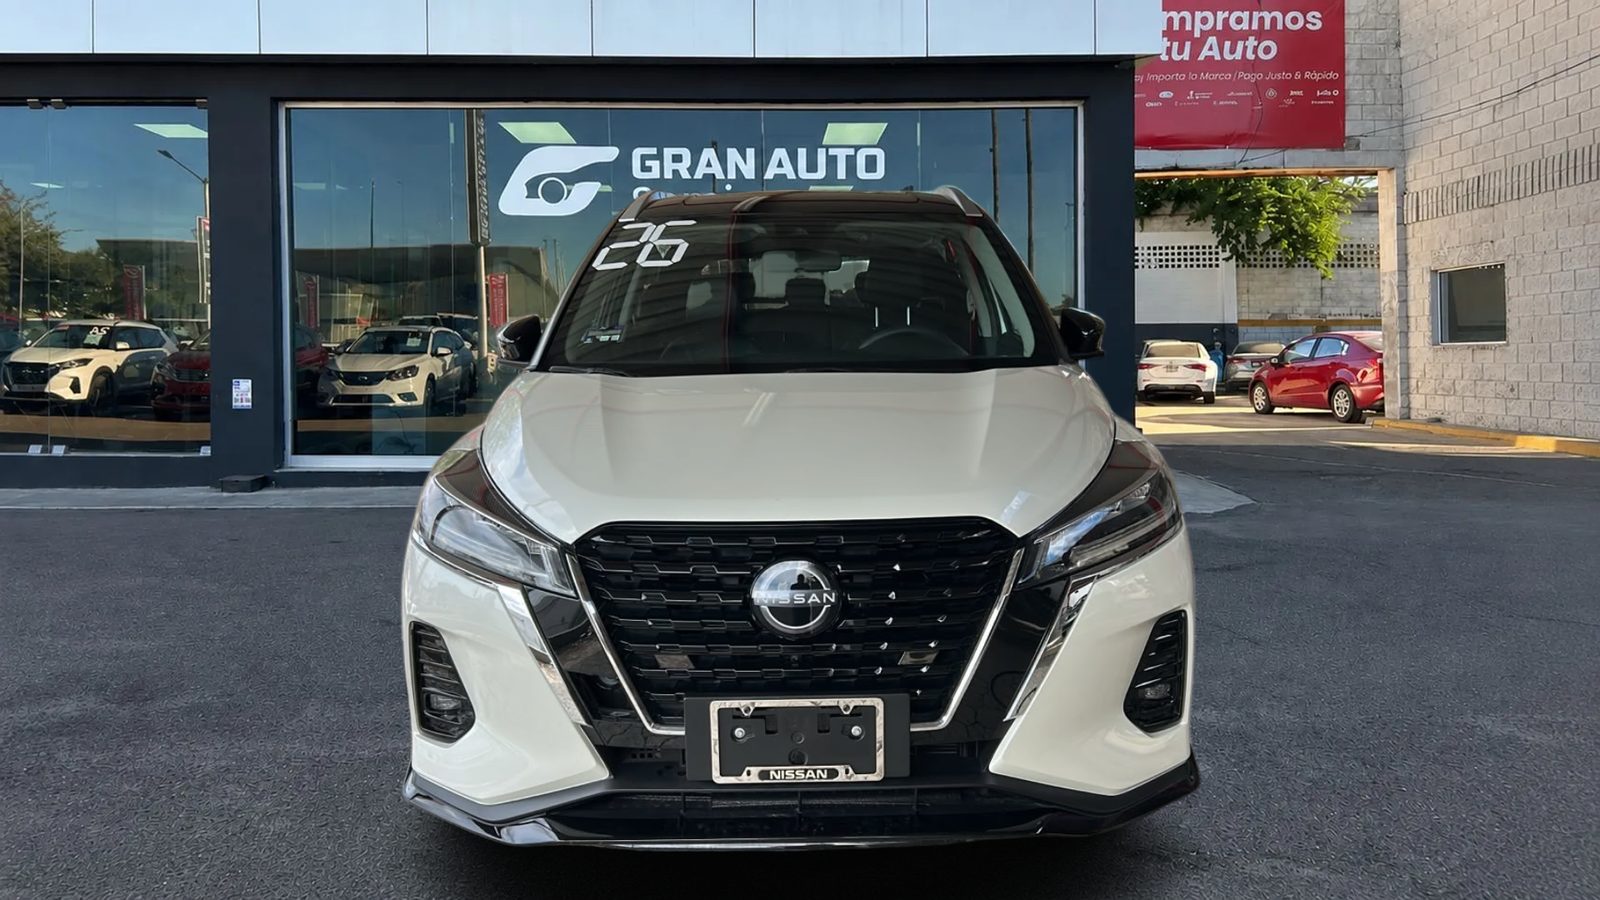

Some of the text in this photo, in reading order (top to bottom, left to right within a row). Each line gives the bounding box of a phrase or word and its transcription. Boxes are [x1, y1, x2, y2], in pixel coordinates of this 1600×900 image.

[1160, 36, 1278, 61] tu Auto
[1146, 73, 1186, 83] Importa
[1188, 72, 1198, 80] la
[1199, 72, 1232, 80] Marca
[1265, 71, 1292, 80] Justo
[1294, 71, 1301, 80] &
[1304, 70, 1339, 82] Rápido
[631, 147, 886, 180] GRAN AUTO
[592, 220, 697, 271] 26
[756, 592, 836, 604] NISSAN
[769, 769, 828, 780] NISSAN
